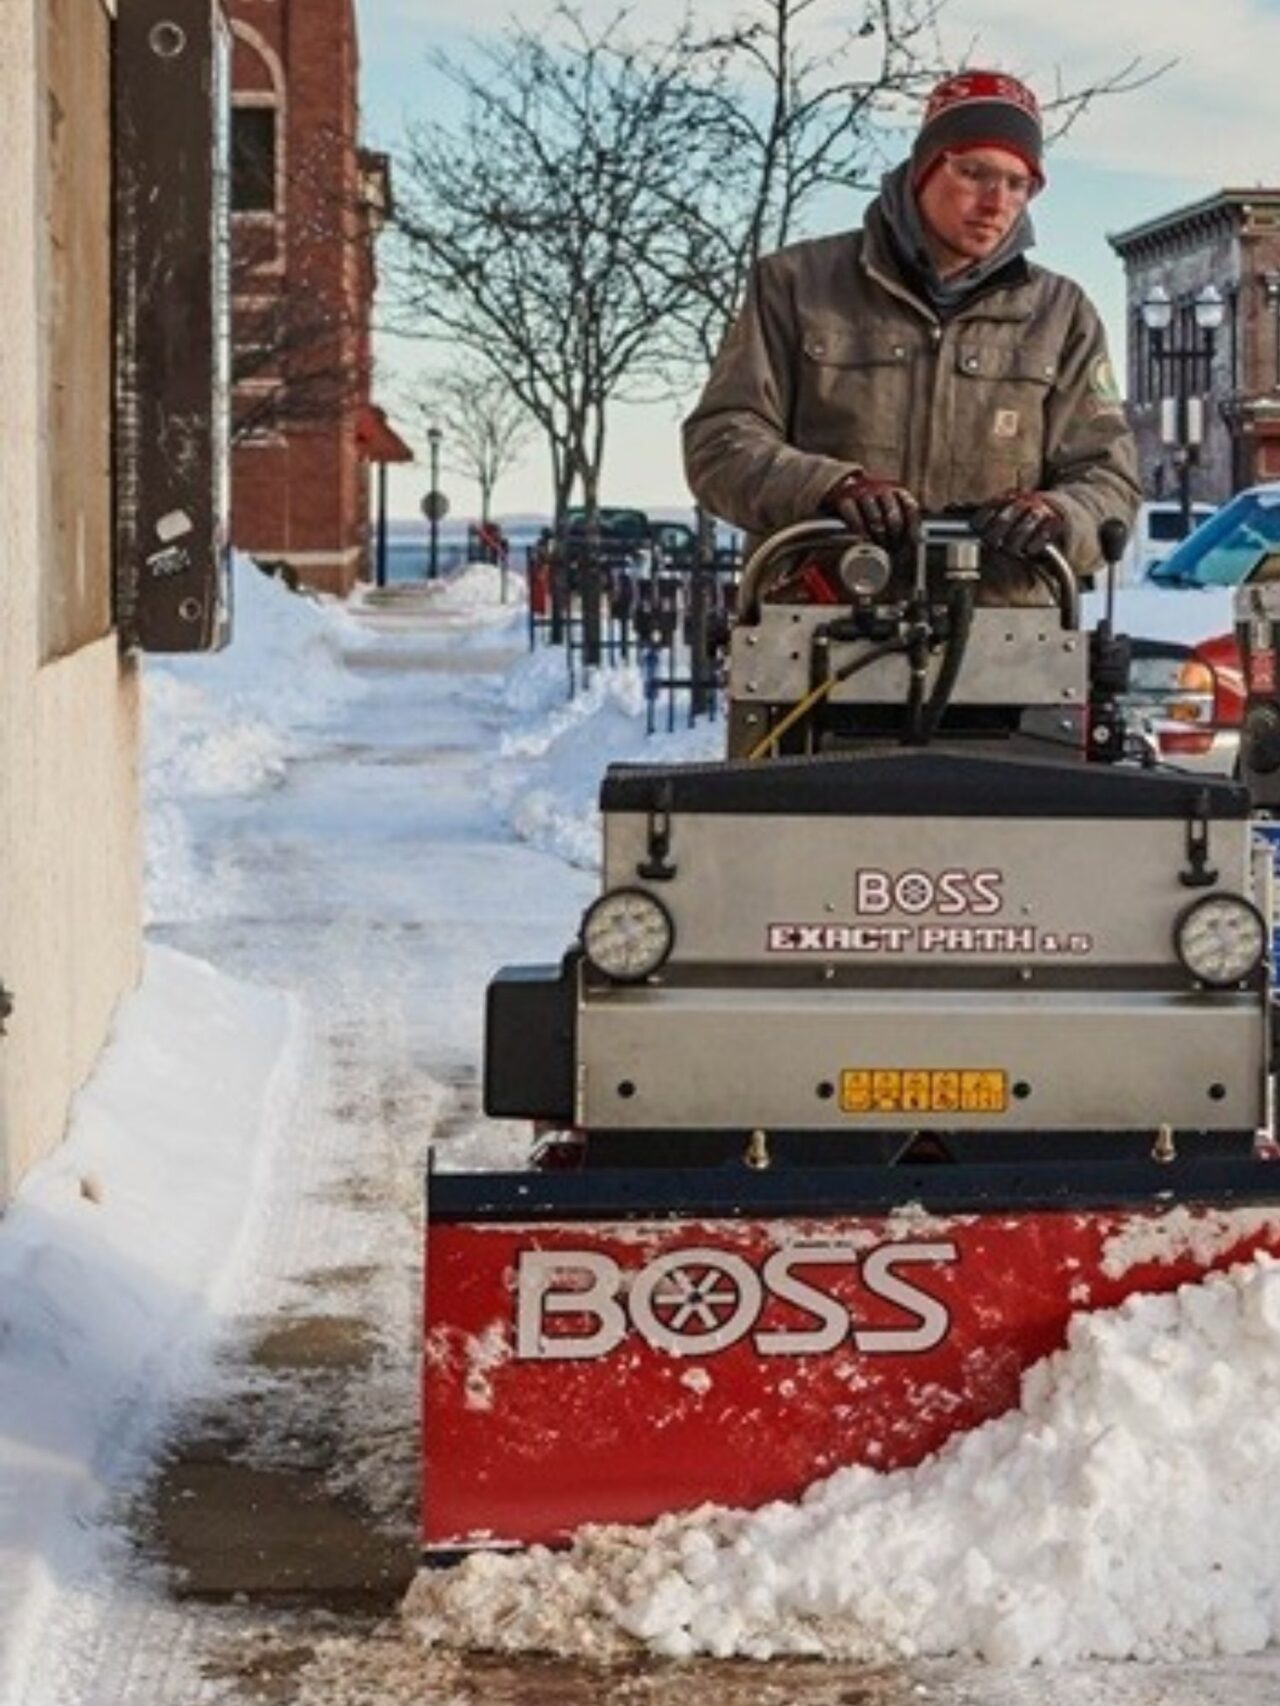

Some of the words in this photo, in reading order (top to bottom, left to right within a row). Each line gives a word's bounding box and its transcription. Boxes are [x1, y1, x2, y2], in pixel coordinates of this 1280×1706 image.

[856, 869, 1001, 914] BOSS
[768, 924, 912, 951] EXACT
[918, 924, 1037, 951] PATH
[517, 1243, 958, 1359] BOSS
